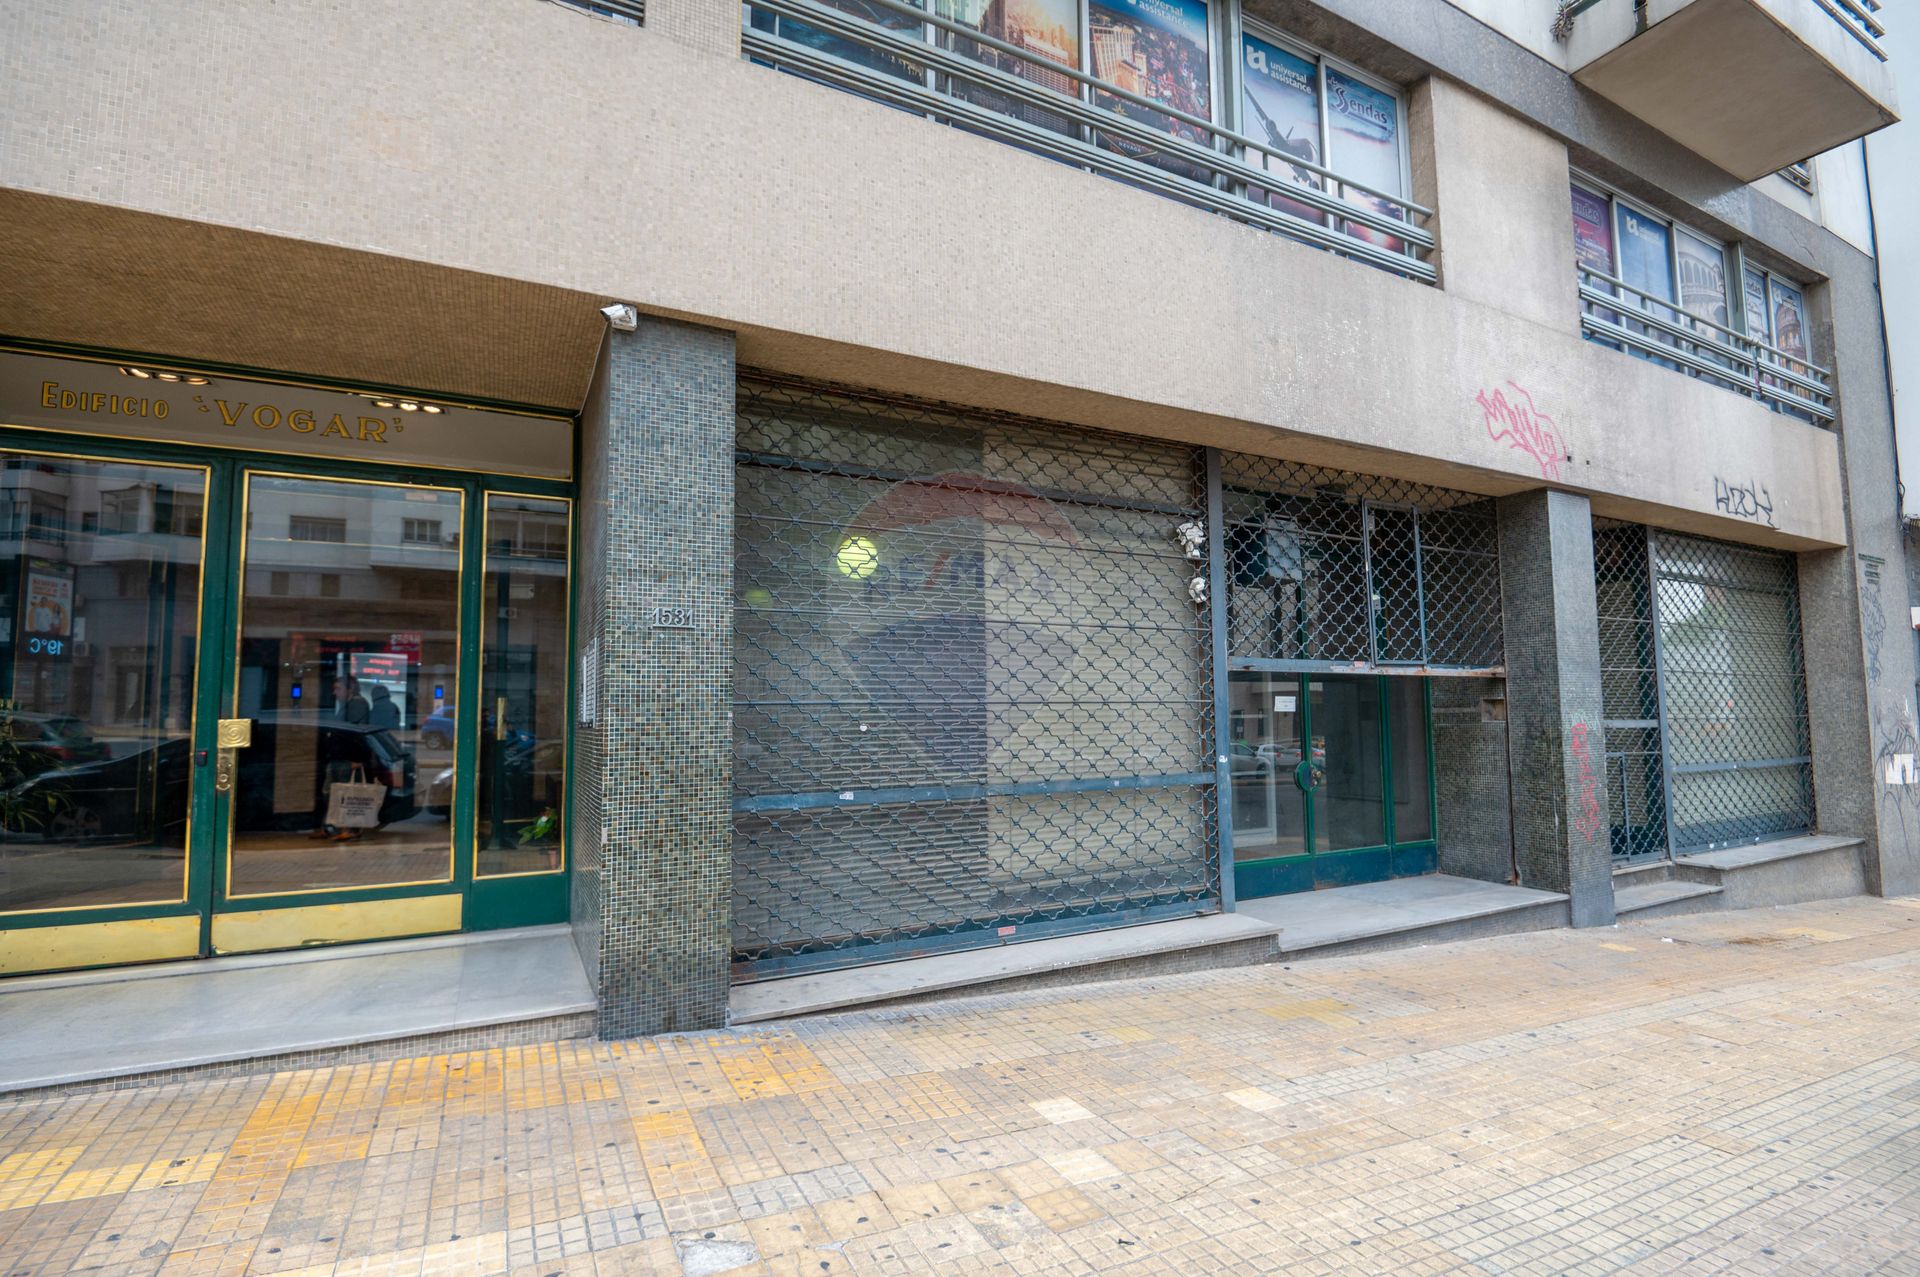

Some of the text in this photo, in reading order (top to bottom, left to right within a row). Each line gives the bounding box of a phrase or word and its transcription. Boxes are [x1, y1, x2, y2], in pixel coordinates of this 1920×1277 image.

[1270, 61, 1307, 83] universal
[1270, 71, 1312, 94] assistance
[1334, 87, 1388, 124] Sendas
[41, 381, 169, 420] EDIFICIO
[651, 607, 694, 627] 1531
